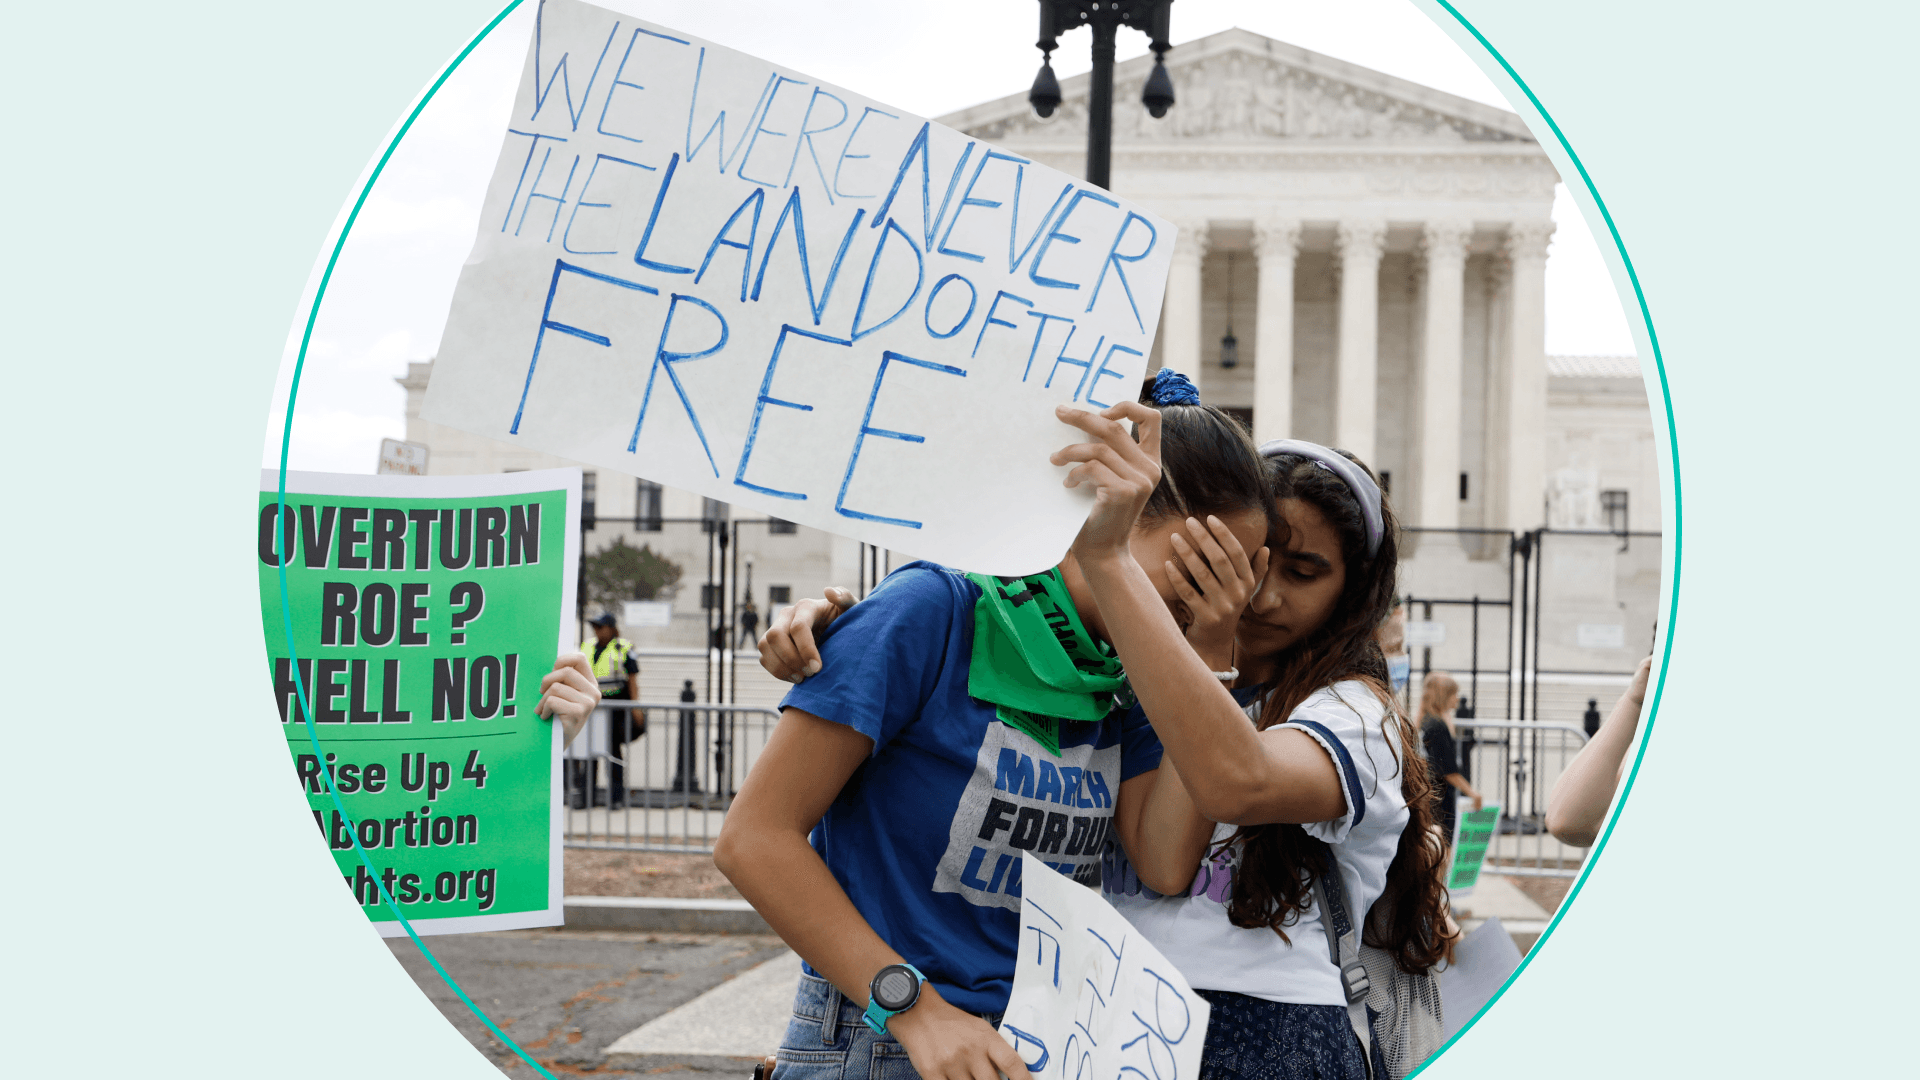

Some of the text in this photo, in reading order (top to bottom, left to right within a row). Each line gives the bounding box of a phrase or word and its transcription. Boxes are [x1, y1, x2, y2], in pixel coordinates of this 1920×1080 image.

[531, 0, 1158, 335] WE WERE NEVER
[501, 128, 1144, 410] THE LAND OF THE
[509, 258, 967, 530] FREE
[258, 503, 541, 571] OVERTURN
[321, 581, 485, 647] ROE ?
[273, 653, 519, 724] HELL NO!
[297, 749, 487, 801] Rise Up 4
[978, 797, 1068, 855] FOR
[344, 865, 497, 911] hts.org
[1026, 898, 1062, 988] IF
